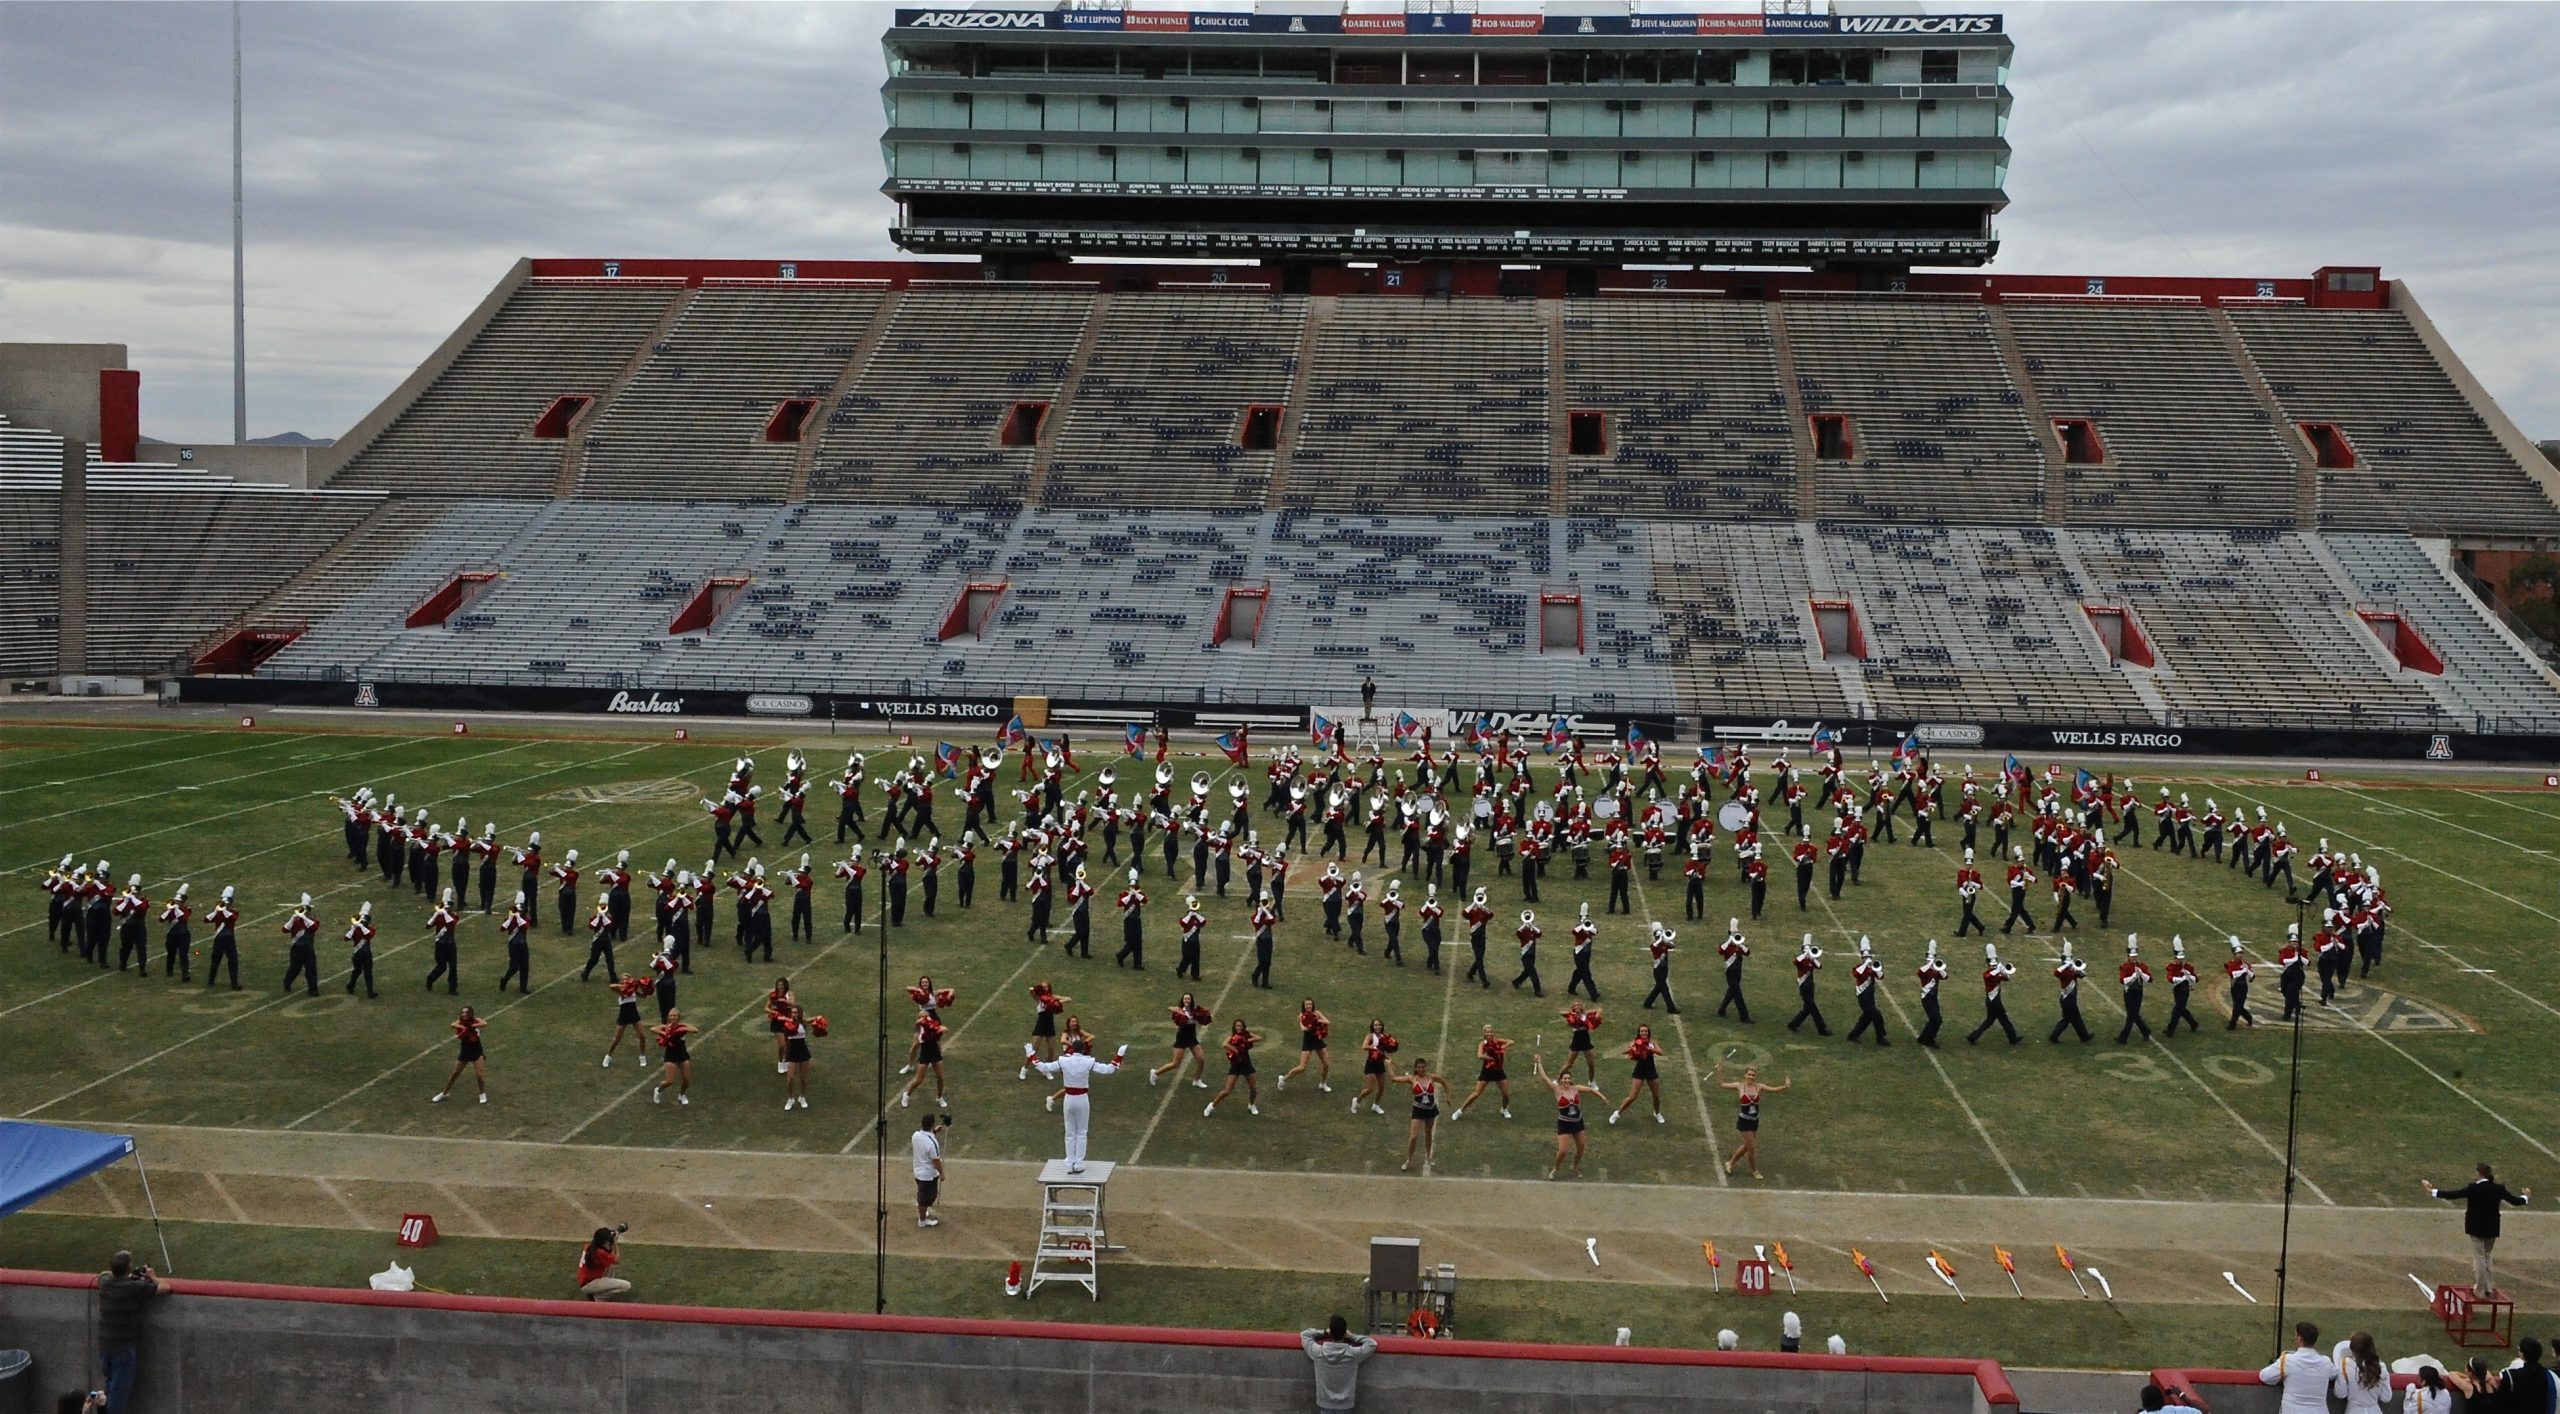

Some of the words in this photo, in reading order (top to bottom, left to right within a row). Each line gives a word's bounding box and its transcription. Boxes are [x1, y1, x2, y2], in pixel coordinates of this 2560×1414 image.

[911, 13, 1045, 28] ARIZONA
[1064, 15, 1072, 24] 22
[1074, 16, 1086, 24] ART
[1088, 16, 1120, 24] LUPPINO
[1200, 18, 1227, 26] CHUCK
[1698, 19, 1704, 27] 11
[1766, 19, 1770, 28] 5
[1771, 20, 1802, 28] ANTOINE
[1804, 20, 1829, 28] CASON
[1840, 18, 1993, 32] WILDCATS
[606, 267, 618, 277] 17
[782, 268, 794, 278] 18
[984, 271, 996, 281] 19
[1212, 274, 1226, 284] 20
[1387, 275, 1400, 285] 21
[1653, 279, 1667, 288] 22
[1892, 282, 1906, 292] 23
[2088, 285, 2103, 295] 24
[2258, 288, 2273, 297] 25
[181, 449, 192, 459] 16
[355, 684, 378, 706] A
[608, 691, 684, 713] Bashas'
[770, 700, 806, 708] CASINOS
[876, 702, 936, 715] WELLS
[940, 703, 998, 716] FARGO
[1430, 717, 1444, 728] DAY
[1449, 711, 1584, 736] WIDCAS
[1939, 730, 1978, 738] CASINOS
[2052, 732, 2116, 744] WELLS
[2120, 733, 2182, 747] FARGO
[2426, 735, 2453, 759] A
[2097, 1052, 2275, 1085] 30
[401, 1218, 423, 1242] 40
[1070, 1242, 1087, 1261] 50
[1742, 1266, 1764, 1289] 40
